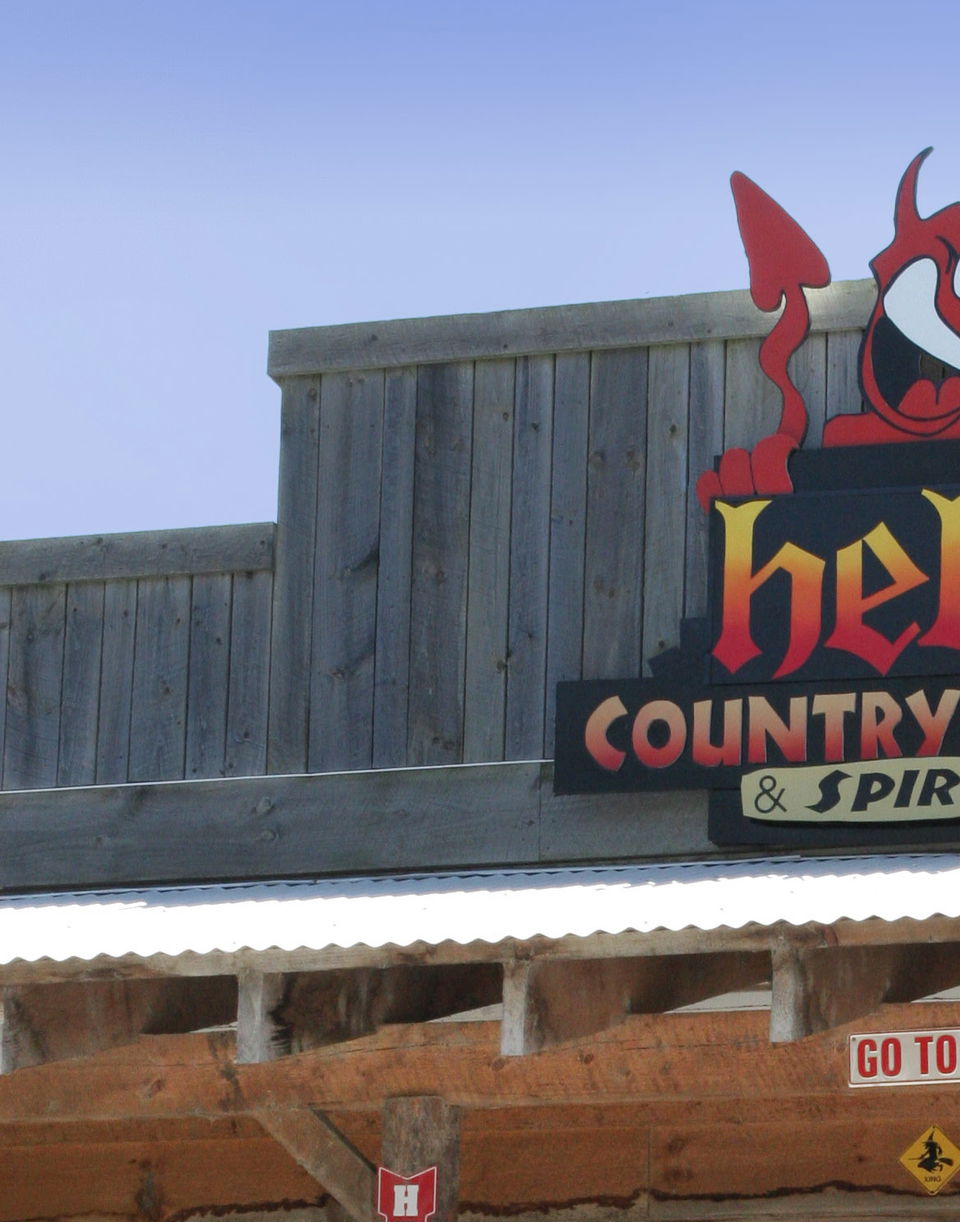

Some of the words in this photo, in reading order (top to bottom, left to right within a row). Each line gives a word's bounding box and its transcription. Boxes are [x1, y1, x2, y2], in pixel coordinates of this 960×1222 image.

[753, 775, 787, 814] &
[856, 1036, 902, 1078] GO
[914, 1034, 958, 1075] TO
